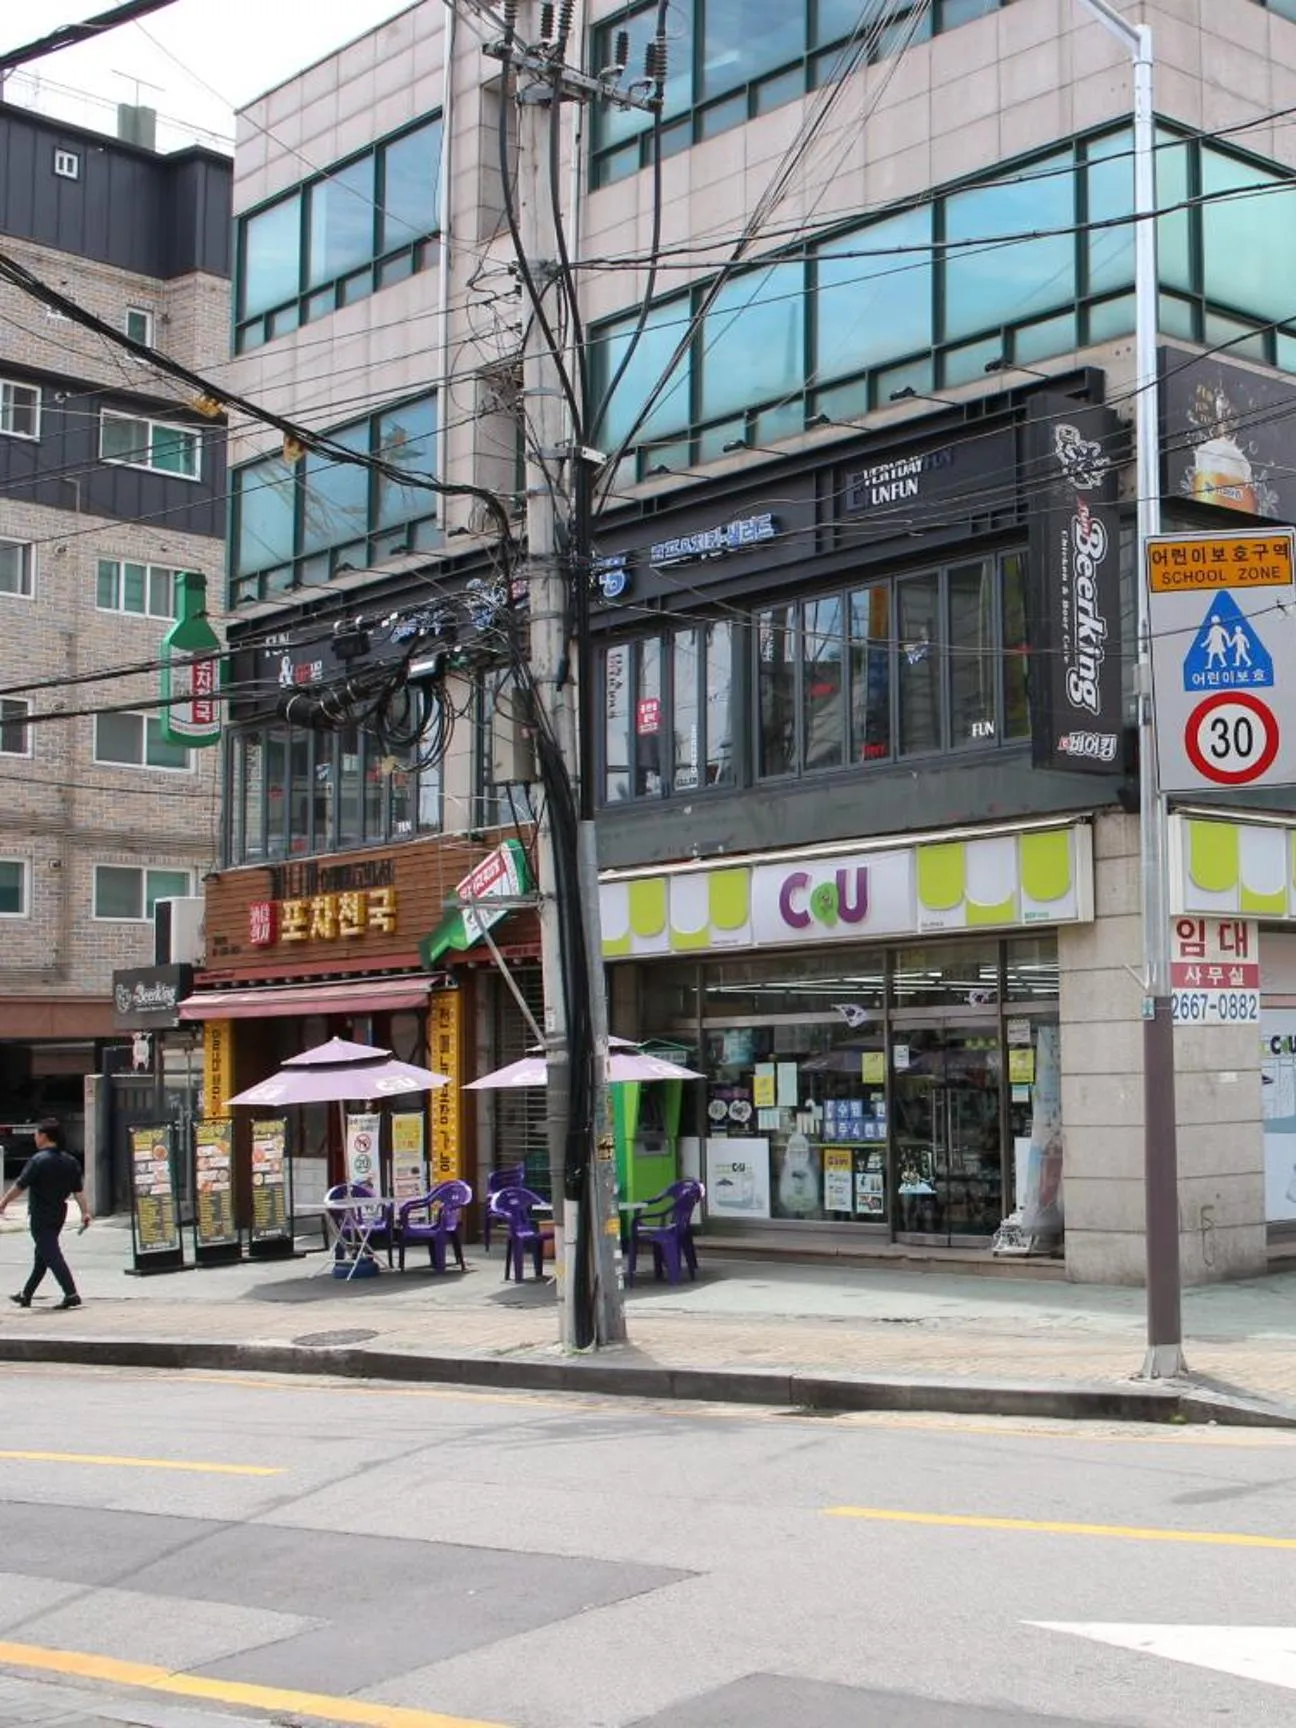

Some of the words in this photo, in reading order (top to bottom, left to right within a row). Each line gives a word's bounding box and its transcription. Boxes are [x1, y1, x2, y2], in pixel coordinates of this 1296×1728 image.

[872, 478, 919, 505] UNFUN
[1152, 541, 1290, 566] 어린이보호구역
[1162, 569, 1227, 585] SCHOOL
[1238, 566, 1280, 580] ZONE
[1066, 517, 1107, 715] Beerking
[1192, 668, 1267, 686] 어린이보호
[1210, 717, 1254, 759] 30
[778, 866, 870, 930] CU
[281, 885, 396, 942] 포차천국
[1176, 918, 1249, 959] 임대
[1185, 966, 1245, 987] 사무실
[1171, 993, 1257, 1021] 2667-0882
